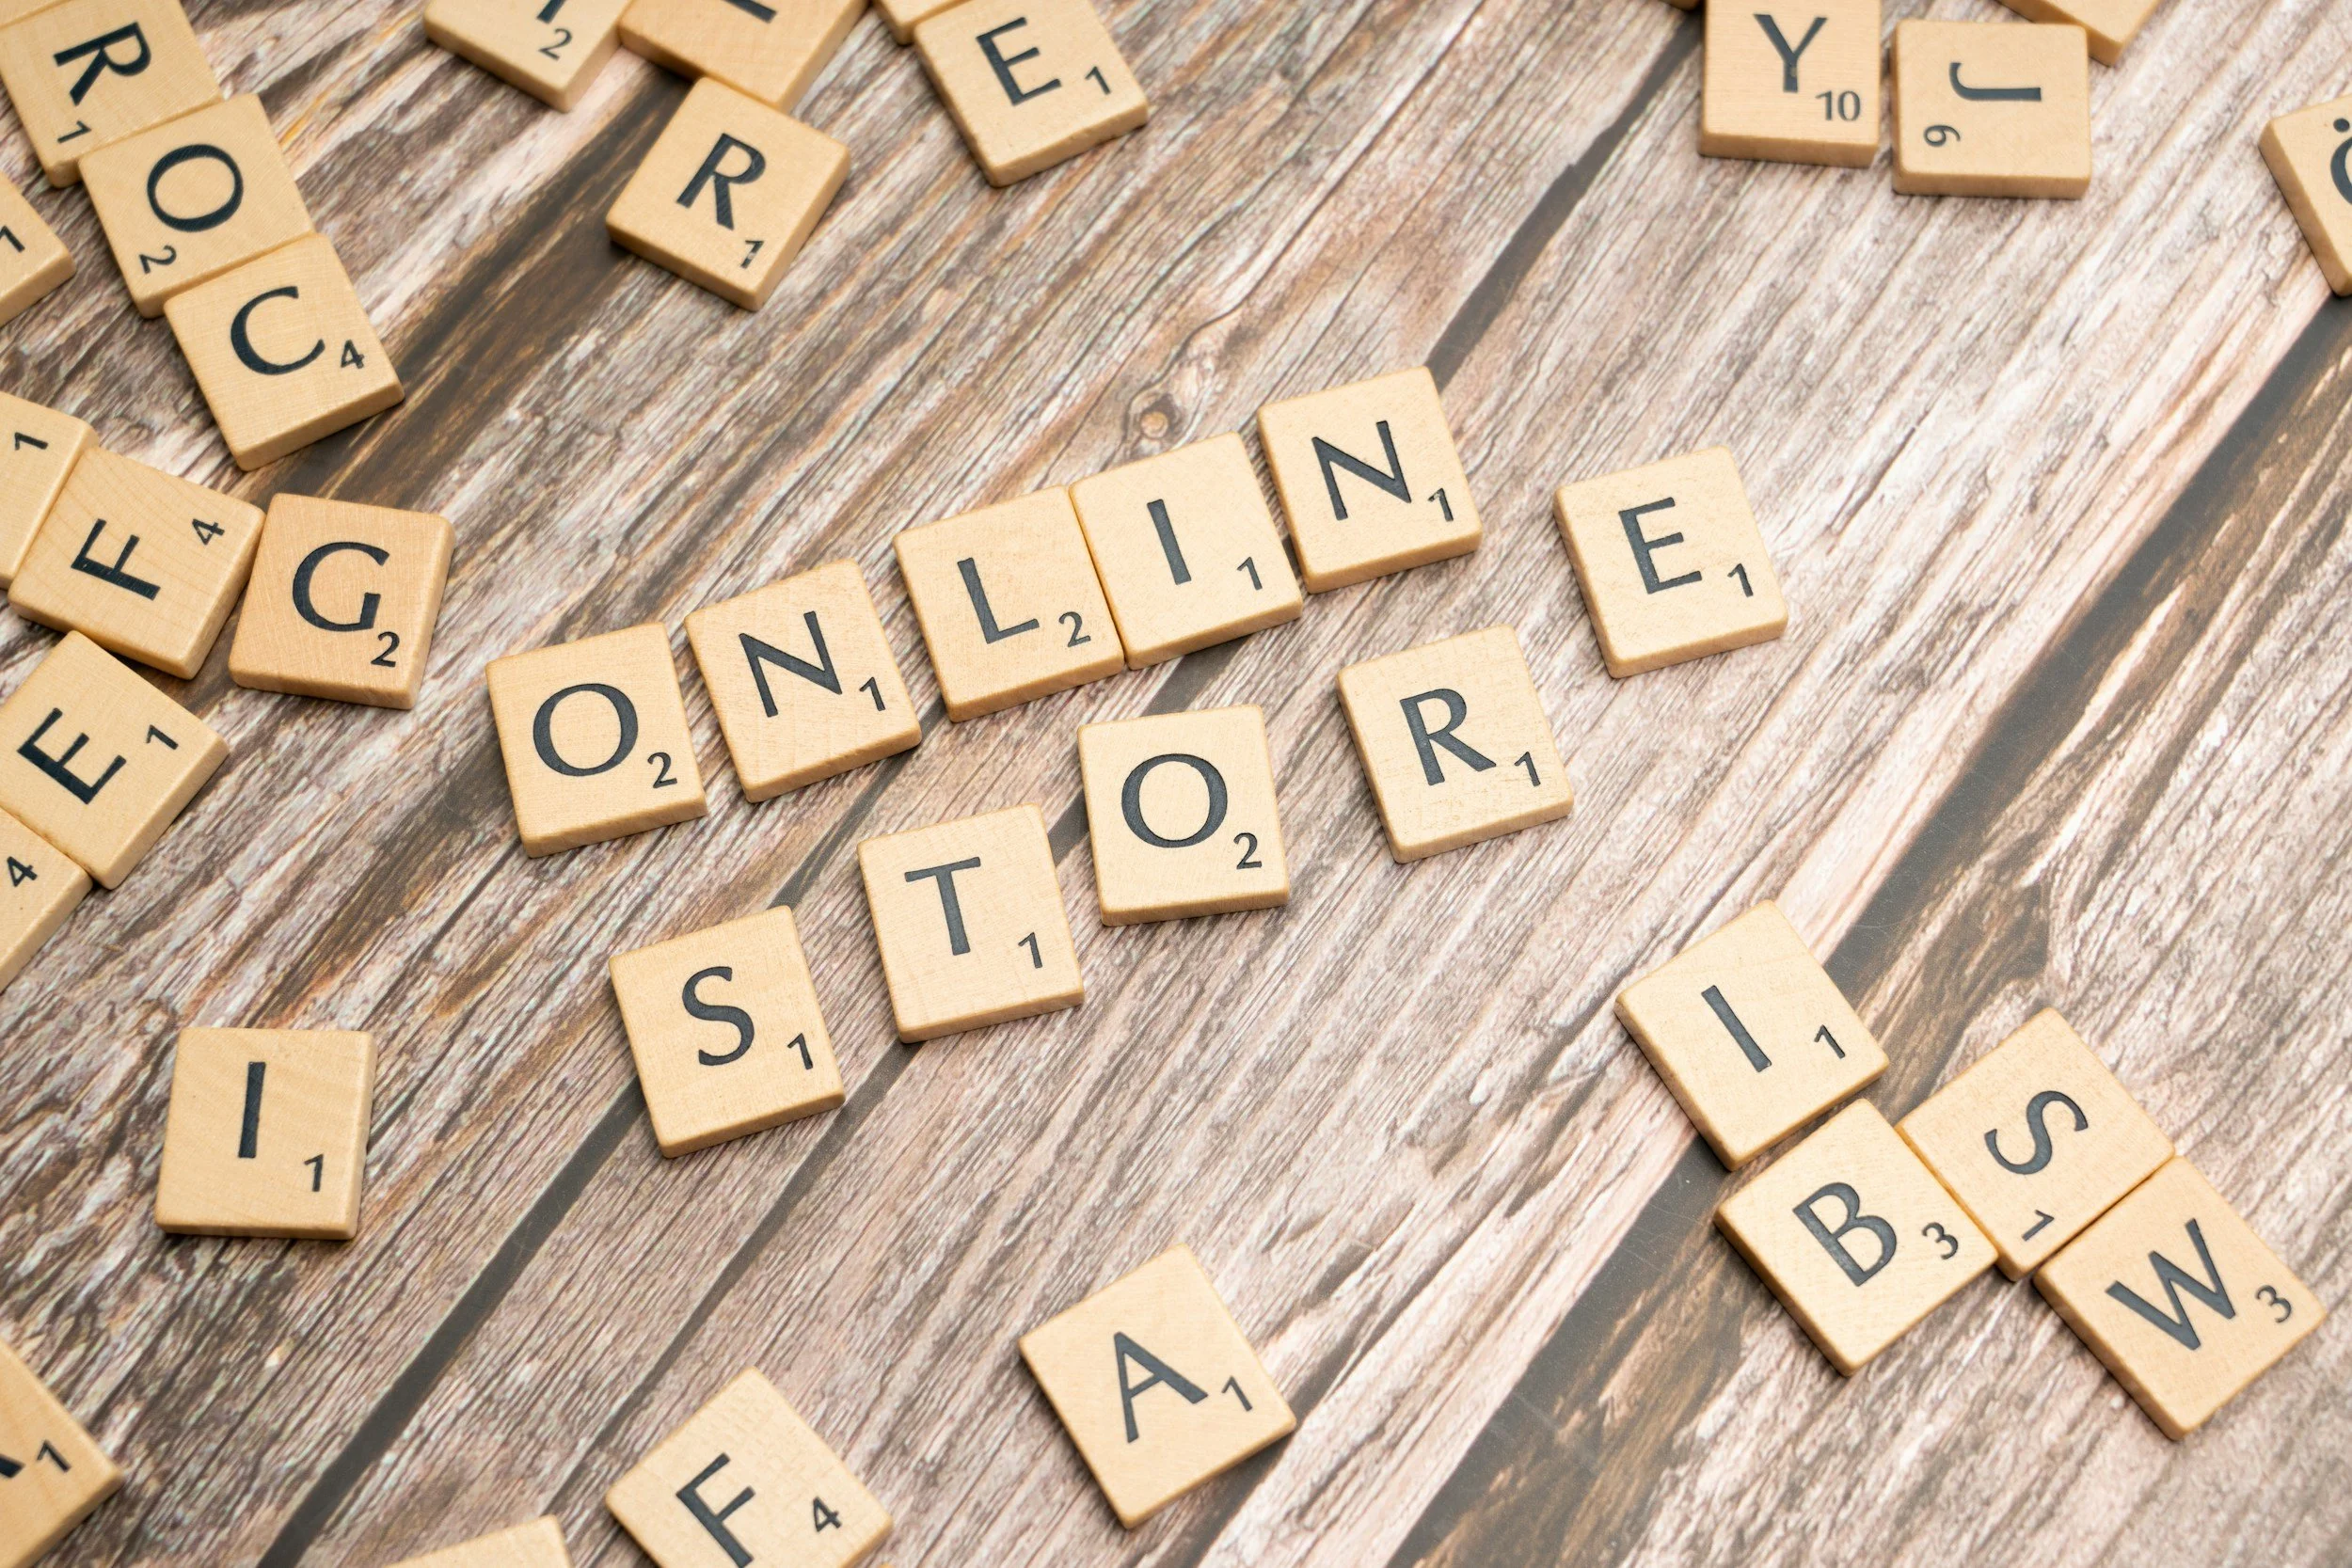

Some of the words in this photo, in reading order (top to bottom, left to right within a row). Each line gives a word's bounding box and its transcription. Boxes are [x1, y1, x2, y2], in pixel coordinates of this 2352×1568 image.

[54, 23, 151, 105] R
[976, 17, 1061, 105] E
[1754, 14, 1827, 92] Y
[1949, 62, 2042, 102] J
[147, 144, 244, 232] O
[676, 133, 766, 230] R
[230, 286, 325, 375] C
[1311, 420, 1412, 520] N
[71, 519, 160, 600] F
[293, 542, 389, 632] G
[1618, 497, 1702, 594] E
[957, 557, 1040, 644] L
[739, 610, 842, 718] N
[17, 708, 126, 804] E
[532, 683, 638, 777] O
[1400, 689, 1497, 785] R
[1121, 753, 1228, 847] O
[904, 857, 981, 956] T
[682, 966, 755, 1066] S
[1984, 1090, 2089, 1175] S
[1792, 1182, 1898, 1287] B
[2106, 1219, 2236, 1350] W
[1114, 1332, 1208, 1443] A
[675, 1453, 755, 1568] F
